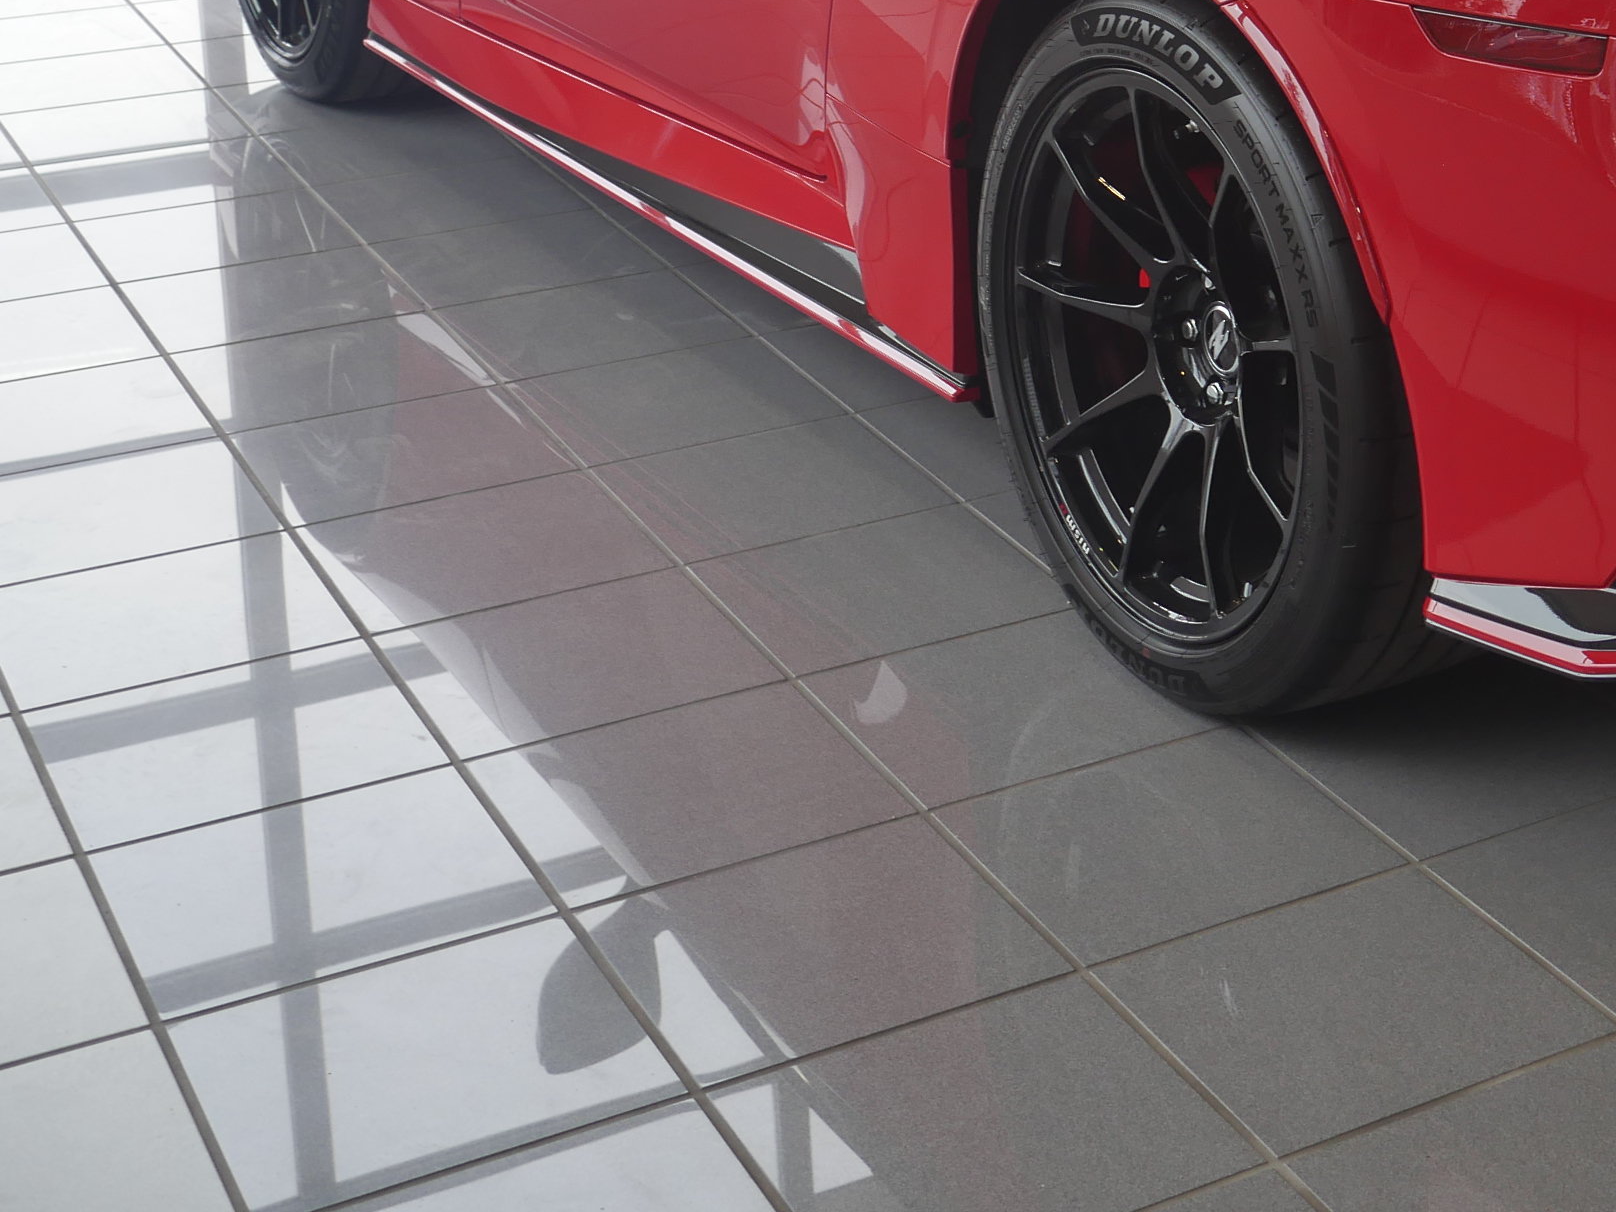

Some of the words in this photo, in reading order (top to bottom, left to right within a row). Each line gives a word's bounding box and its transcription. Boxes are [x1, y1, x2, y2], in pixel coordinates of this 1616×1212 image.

[1093, 13, 1224, 90] DUNLOP
[1232, 119, 1280, 198] SPORT
[1275, 202, 1309, 285] MAXX
[1301, 288, 1320, 328] RS
